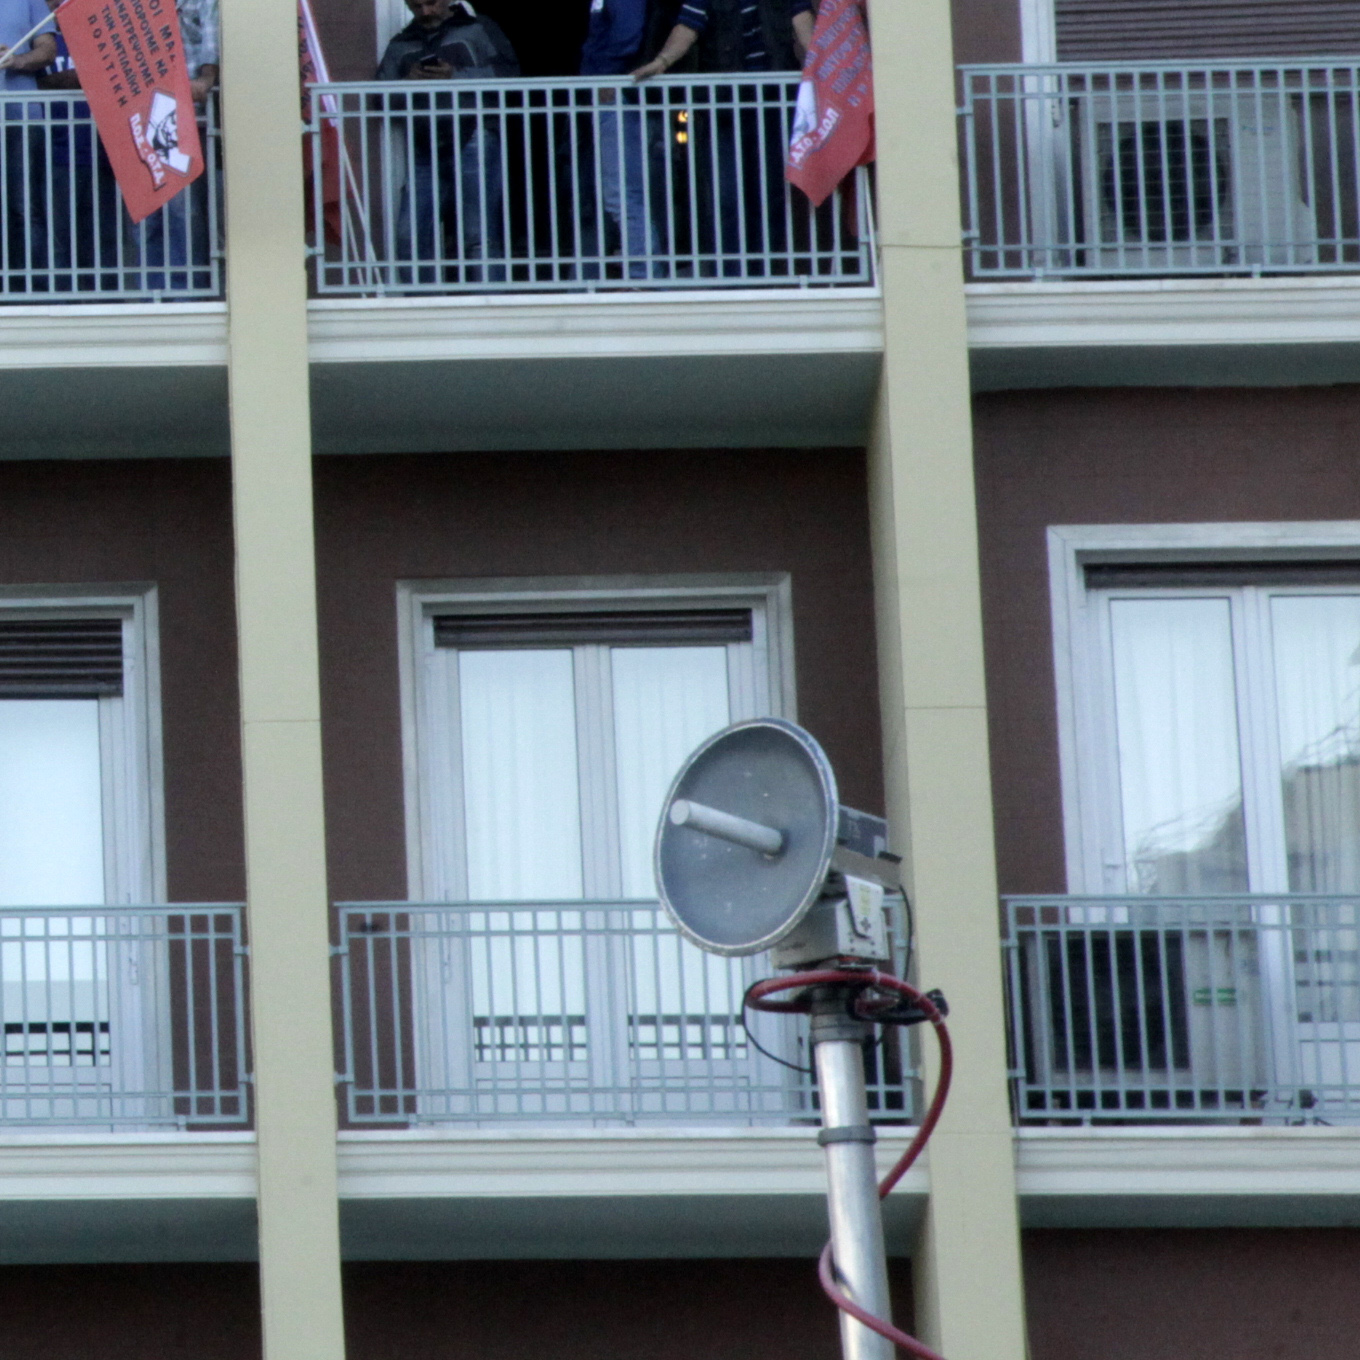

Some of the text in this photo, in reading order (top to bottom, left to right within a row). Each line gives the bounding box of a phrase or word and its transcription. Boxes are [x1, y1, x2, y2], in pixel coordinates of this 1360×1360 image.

[101, 3, 116, 32] ΤΗΝ
[87, 13, 129, 108] ΠΟΛΙΤΙΚΗ
[155, 58, 169, 79] ΝΑ
